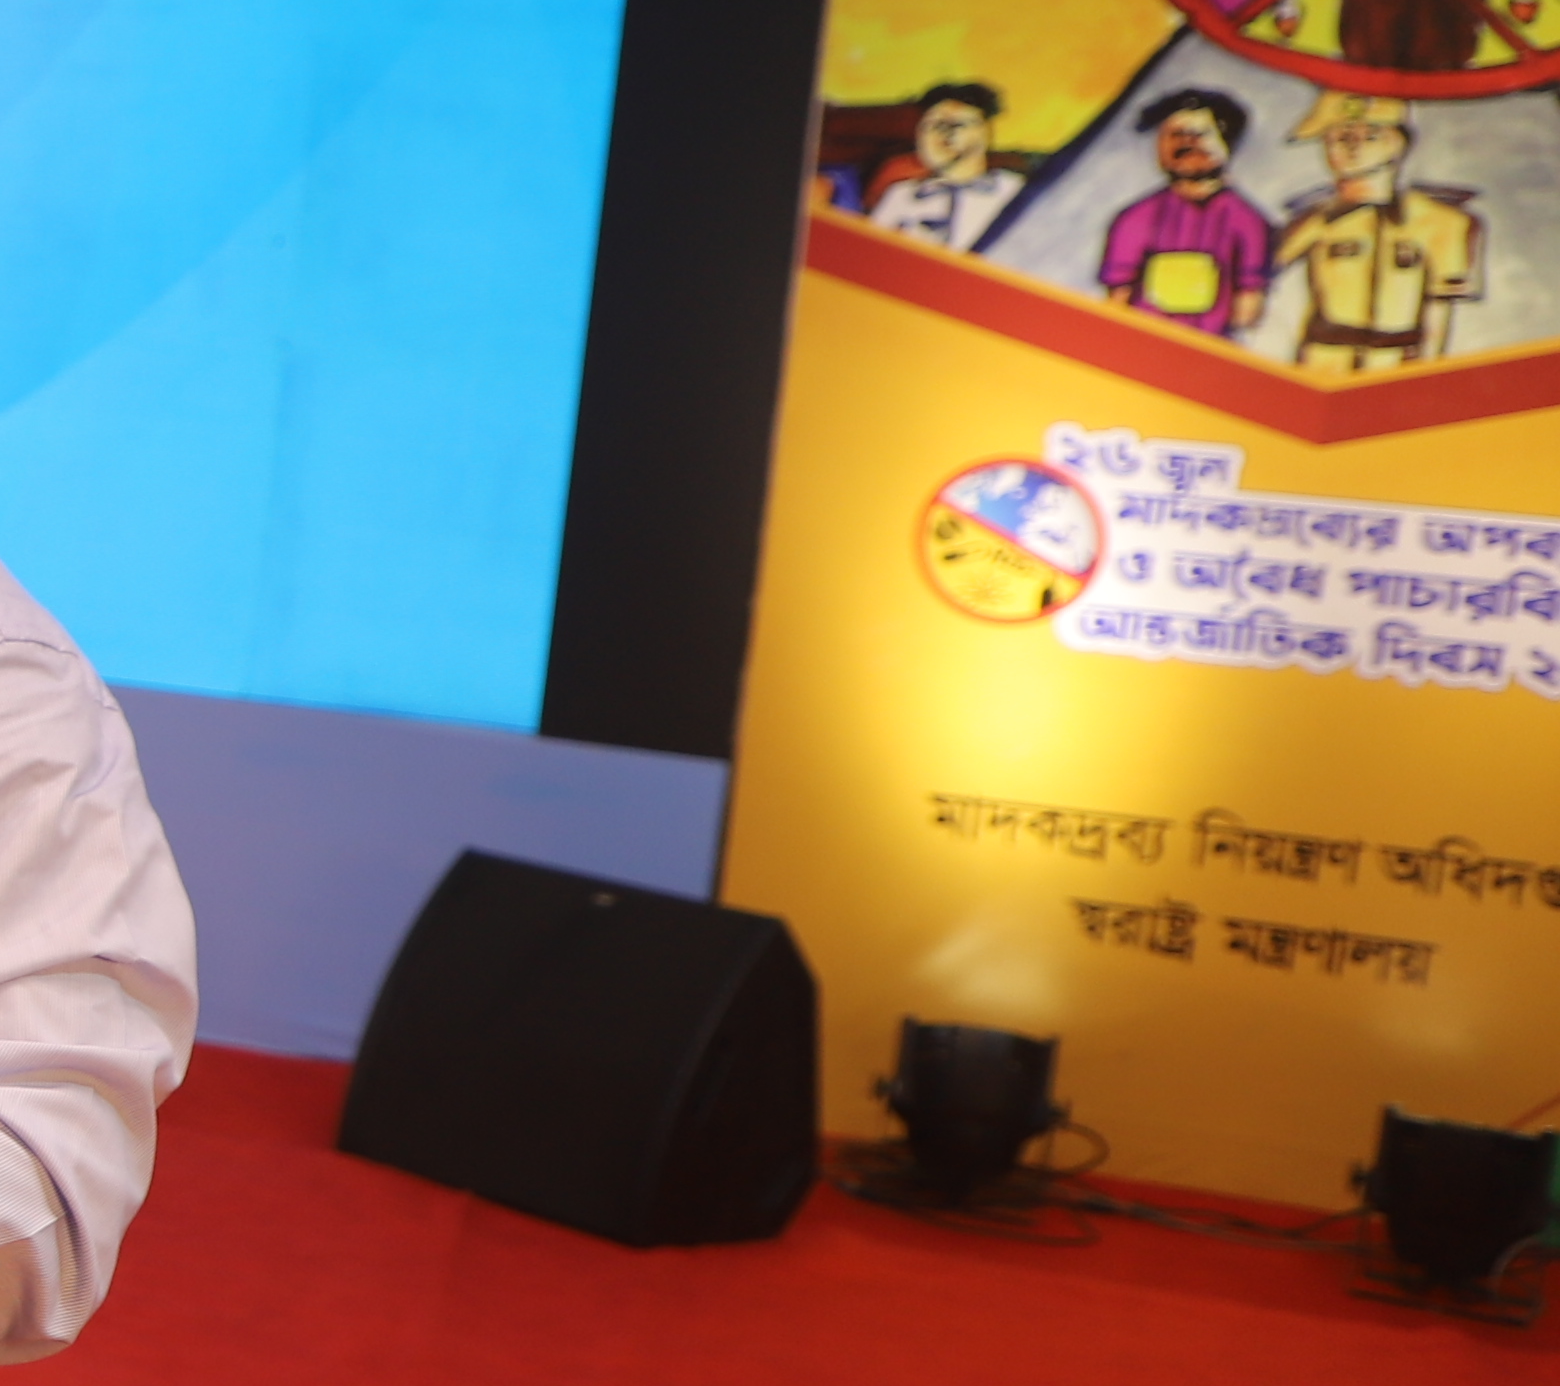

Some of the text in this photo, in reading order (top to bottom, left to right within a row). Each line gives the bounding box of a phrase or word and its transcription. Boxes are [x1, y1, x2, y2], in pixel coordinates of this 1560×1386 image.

[1060, 434, 1231, 492] ২৬ জুন
[1119, 551, 1152, 583] ও
[1174, 549, 1326, 601] অবৈধ
[1374, 619, 1506, 676] দিবস
[929, 791, 1174, 863] মাদকদ্রব্য
[1193, 807, 1364, 886] নিয়ন্ত্রণ
[1222, 915, 1439, 989] মন্ত্রণালয়
